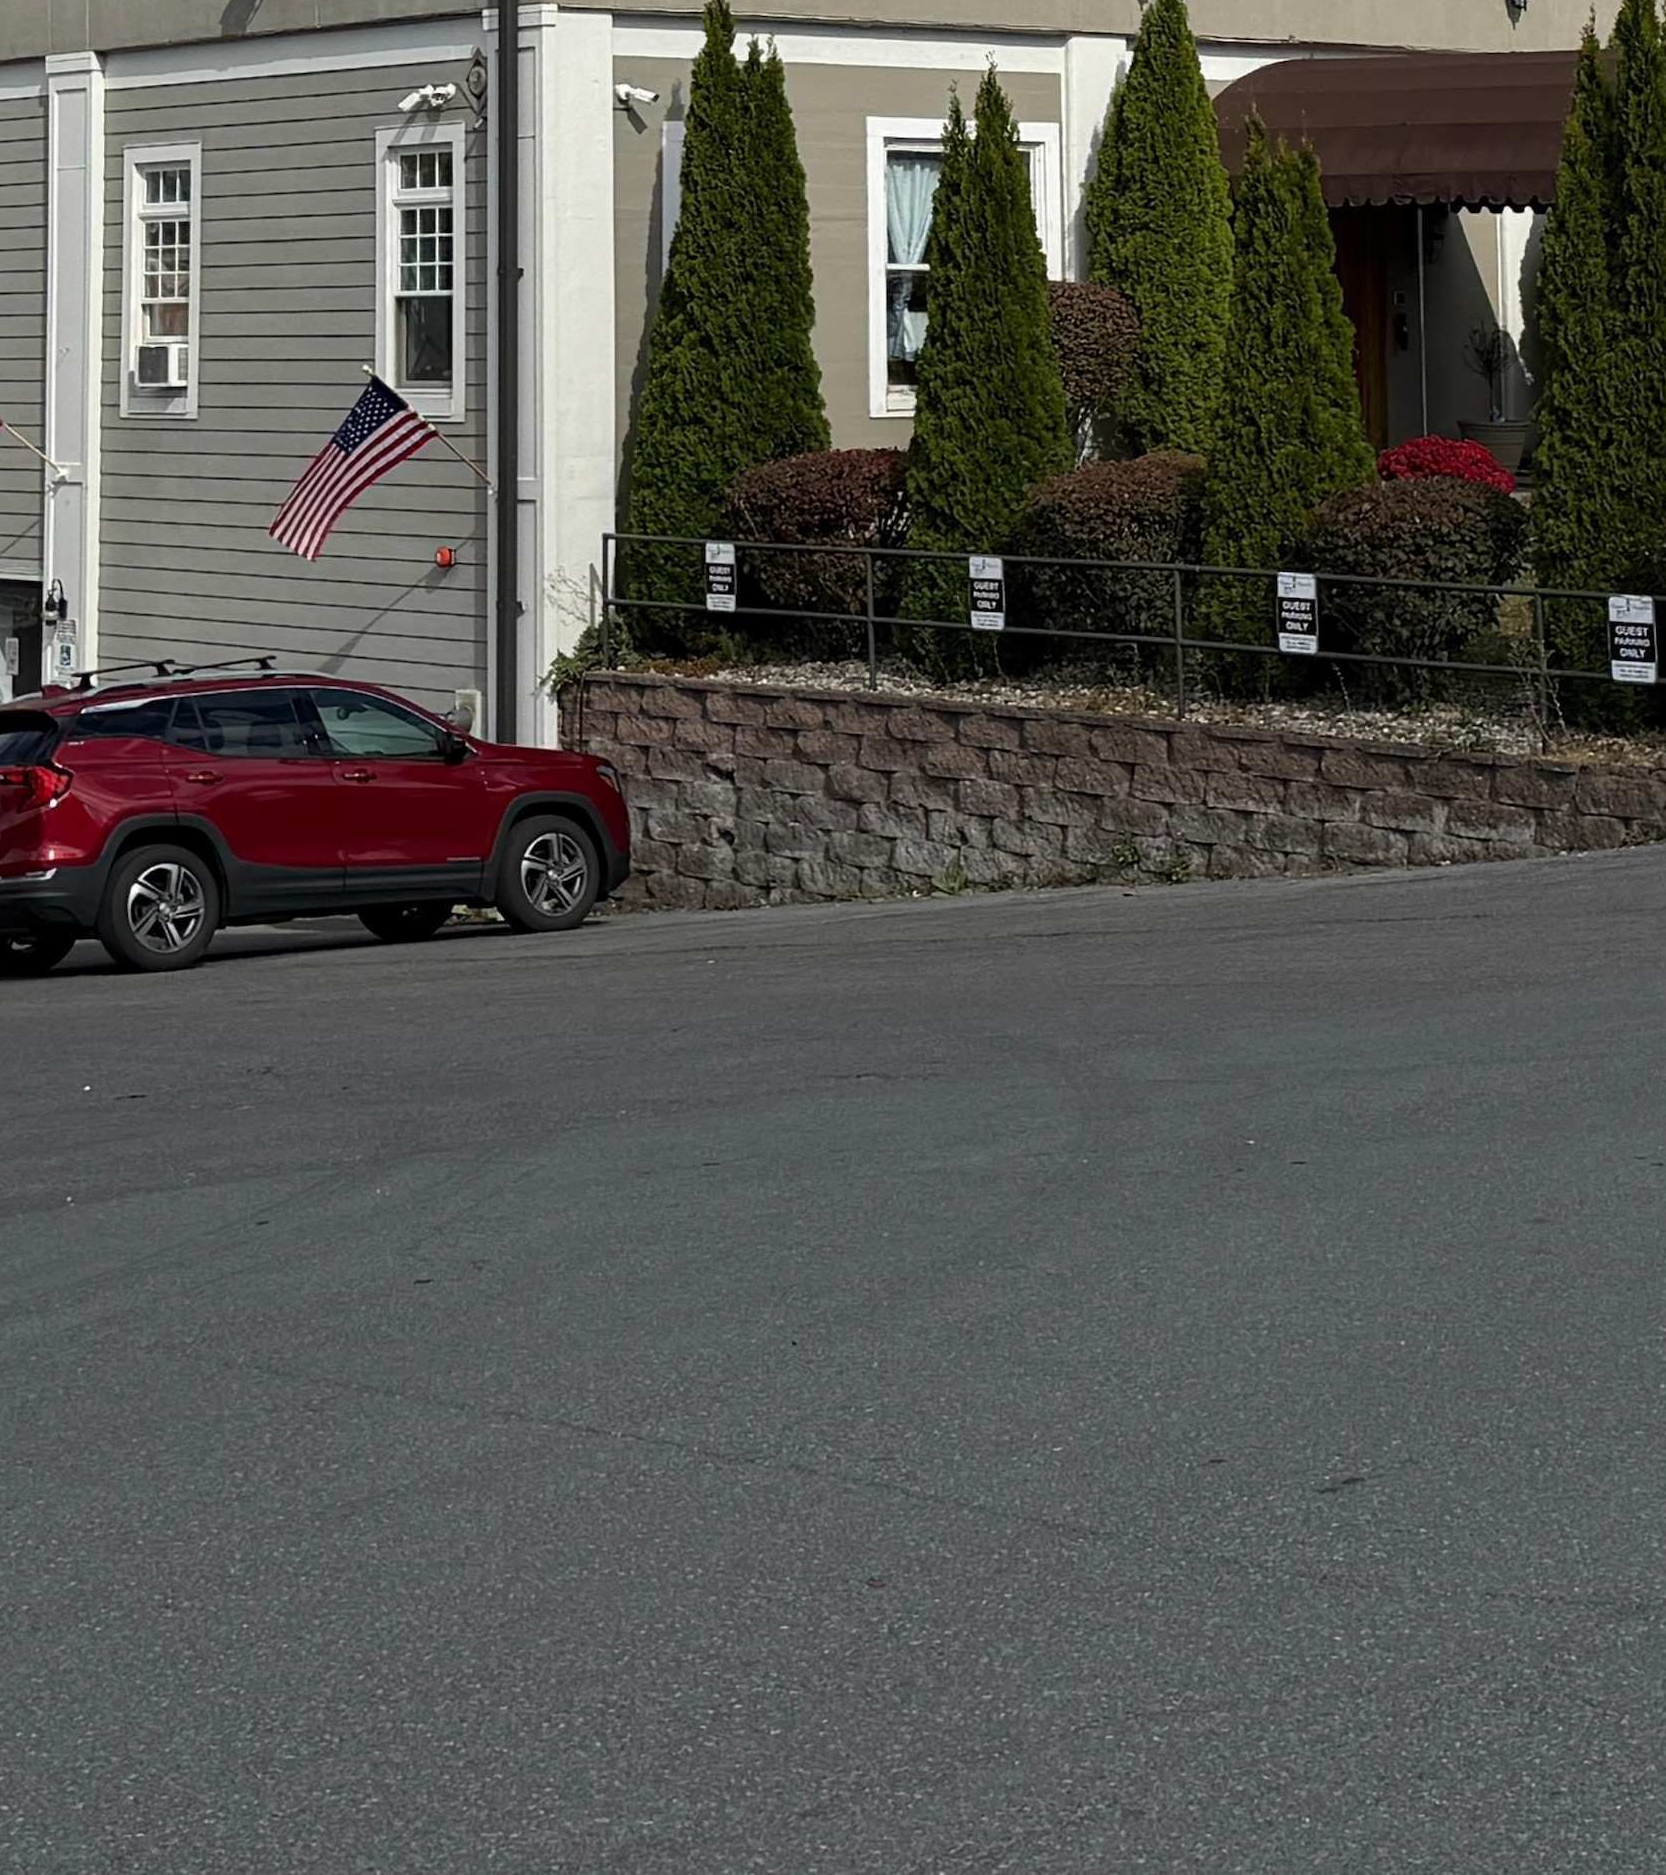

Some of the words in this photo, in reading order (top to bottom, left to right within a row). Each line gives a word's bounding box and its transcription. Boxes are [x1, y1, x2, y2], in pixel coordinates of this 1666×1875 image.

[1282, 600, 1311, 611] GUEST
[1614, 625, 1649, 636] GUEST
[1619, 648, 1646, 658] ONLY
